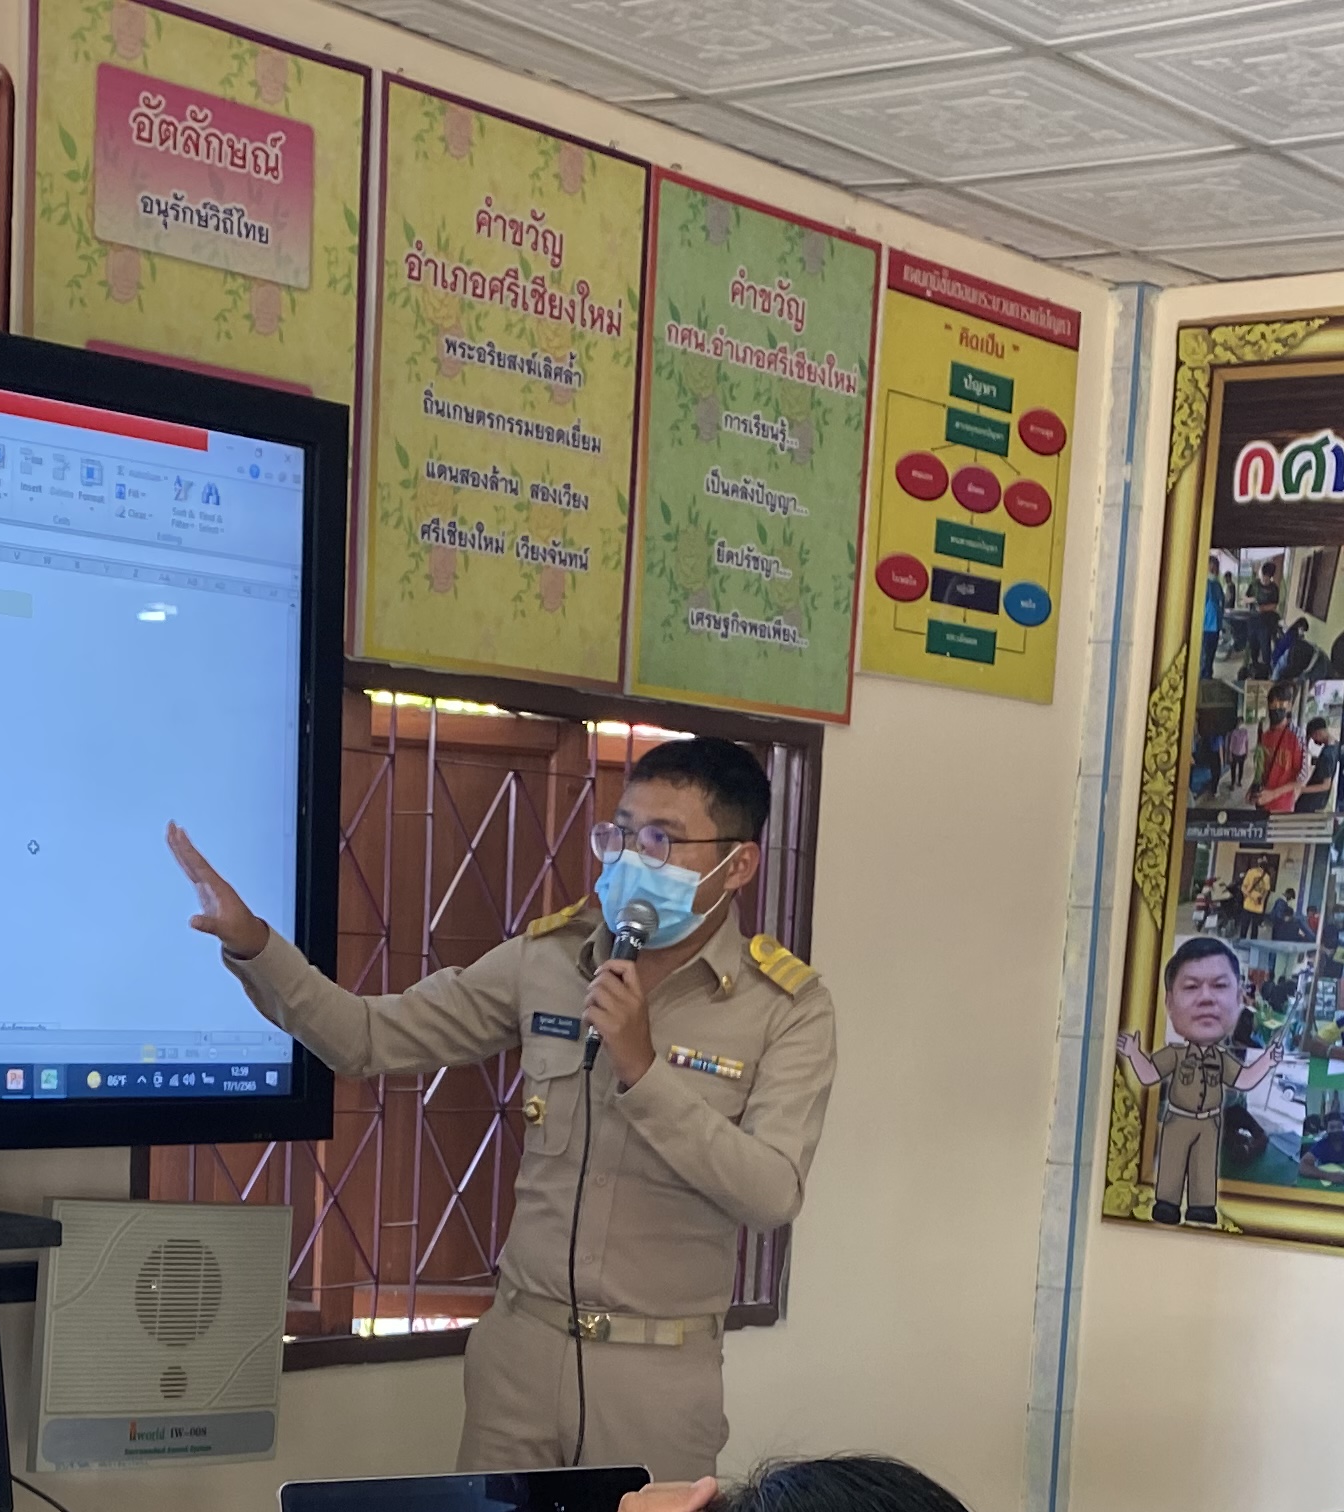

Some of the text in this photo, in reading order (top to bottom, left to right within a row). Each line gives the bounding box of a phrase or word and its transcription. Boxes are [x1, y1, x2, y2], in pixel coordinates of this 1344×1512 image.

[131, 95, 284, 181] อัตลักษณ์
[140, 193, 269, 245] อนุรักษ์วิถีไทย
[475, 195, 564, 268] คำขวัญ
[405, 239, 622, 337] อำเภอศรีเชียงใหม่
[730, 267, 806, 333] คำขวัญ
[445, 336, 582, 388] พระอริยสงฆ์เลิศล้ำ
[667, 324, 857, 394] กศน.อำเภอศรีเชียงใหม่
[423, 383, 602, 453] ถิ่นเกษตรกรรมยอดเยี่ยม
[530, 482, 589, 511] สองเวียง
[420, 518, 589, 571] ศรีเชียงใหม่ เวียงจันทน์
